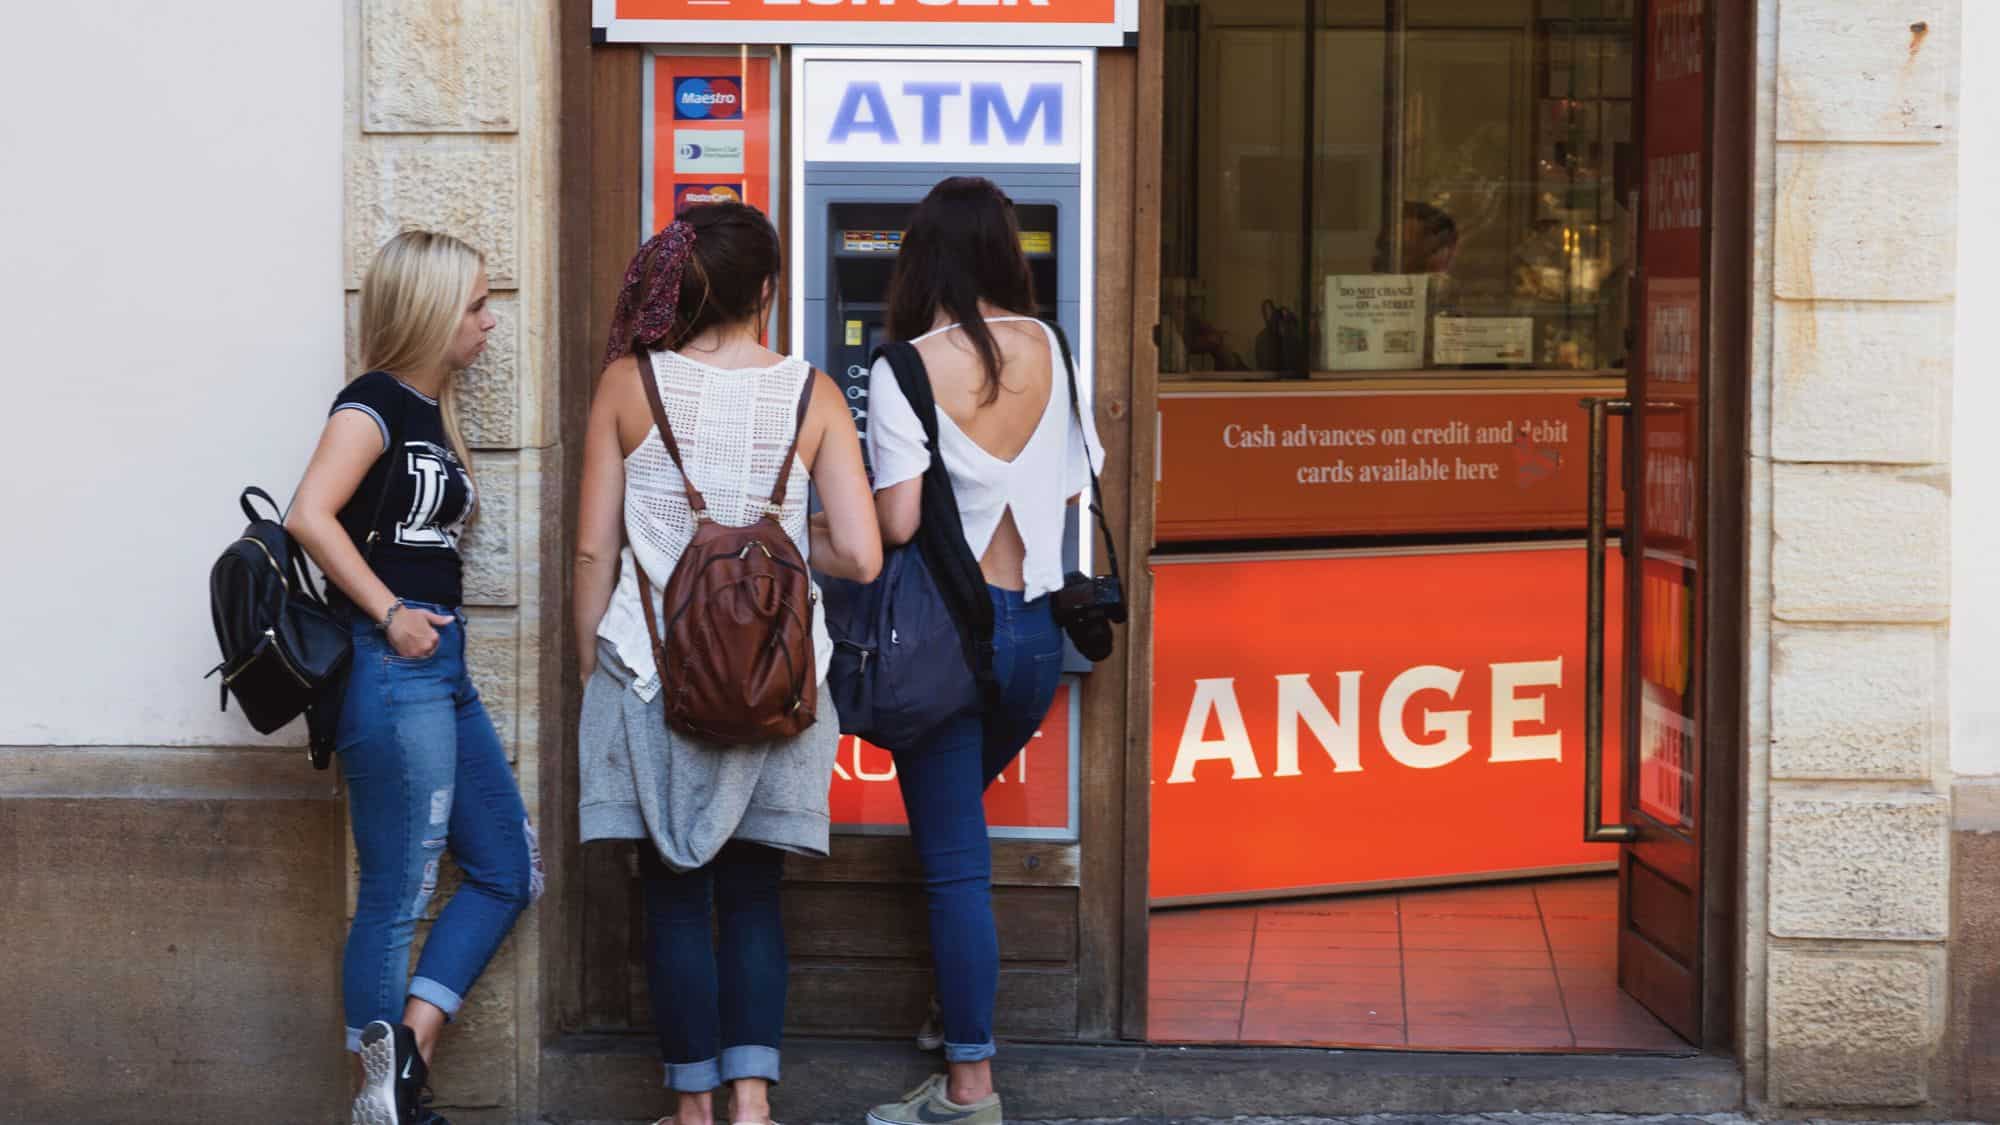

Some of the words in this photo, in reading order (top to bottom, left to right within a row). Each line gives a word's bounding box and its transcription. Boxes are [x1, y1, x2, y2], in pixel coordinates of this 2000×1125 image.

[681, 92, 736, 105] Maestro
[827, 81, 1064, 146] ATM
[1340, 287, 1353, 297] DO
[1358, 287, 1376, 298] NOT
[1223, 423, 1276, 448] Cash
[1281, 423, 1376, 447] advances
[1381, 427, 1406, 446] on
[1411, 421, 1471, 445] credit
[1476, 420, 1513, 444] and
[1297, 459, 1354, 484] cards
[1359, 457, 1451, 482] available
[1455, 456, 1499, 481] here
[1151, 656, 1563, 784] ANGE
